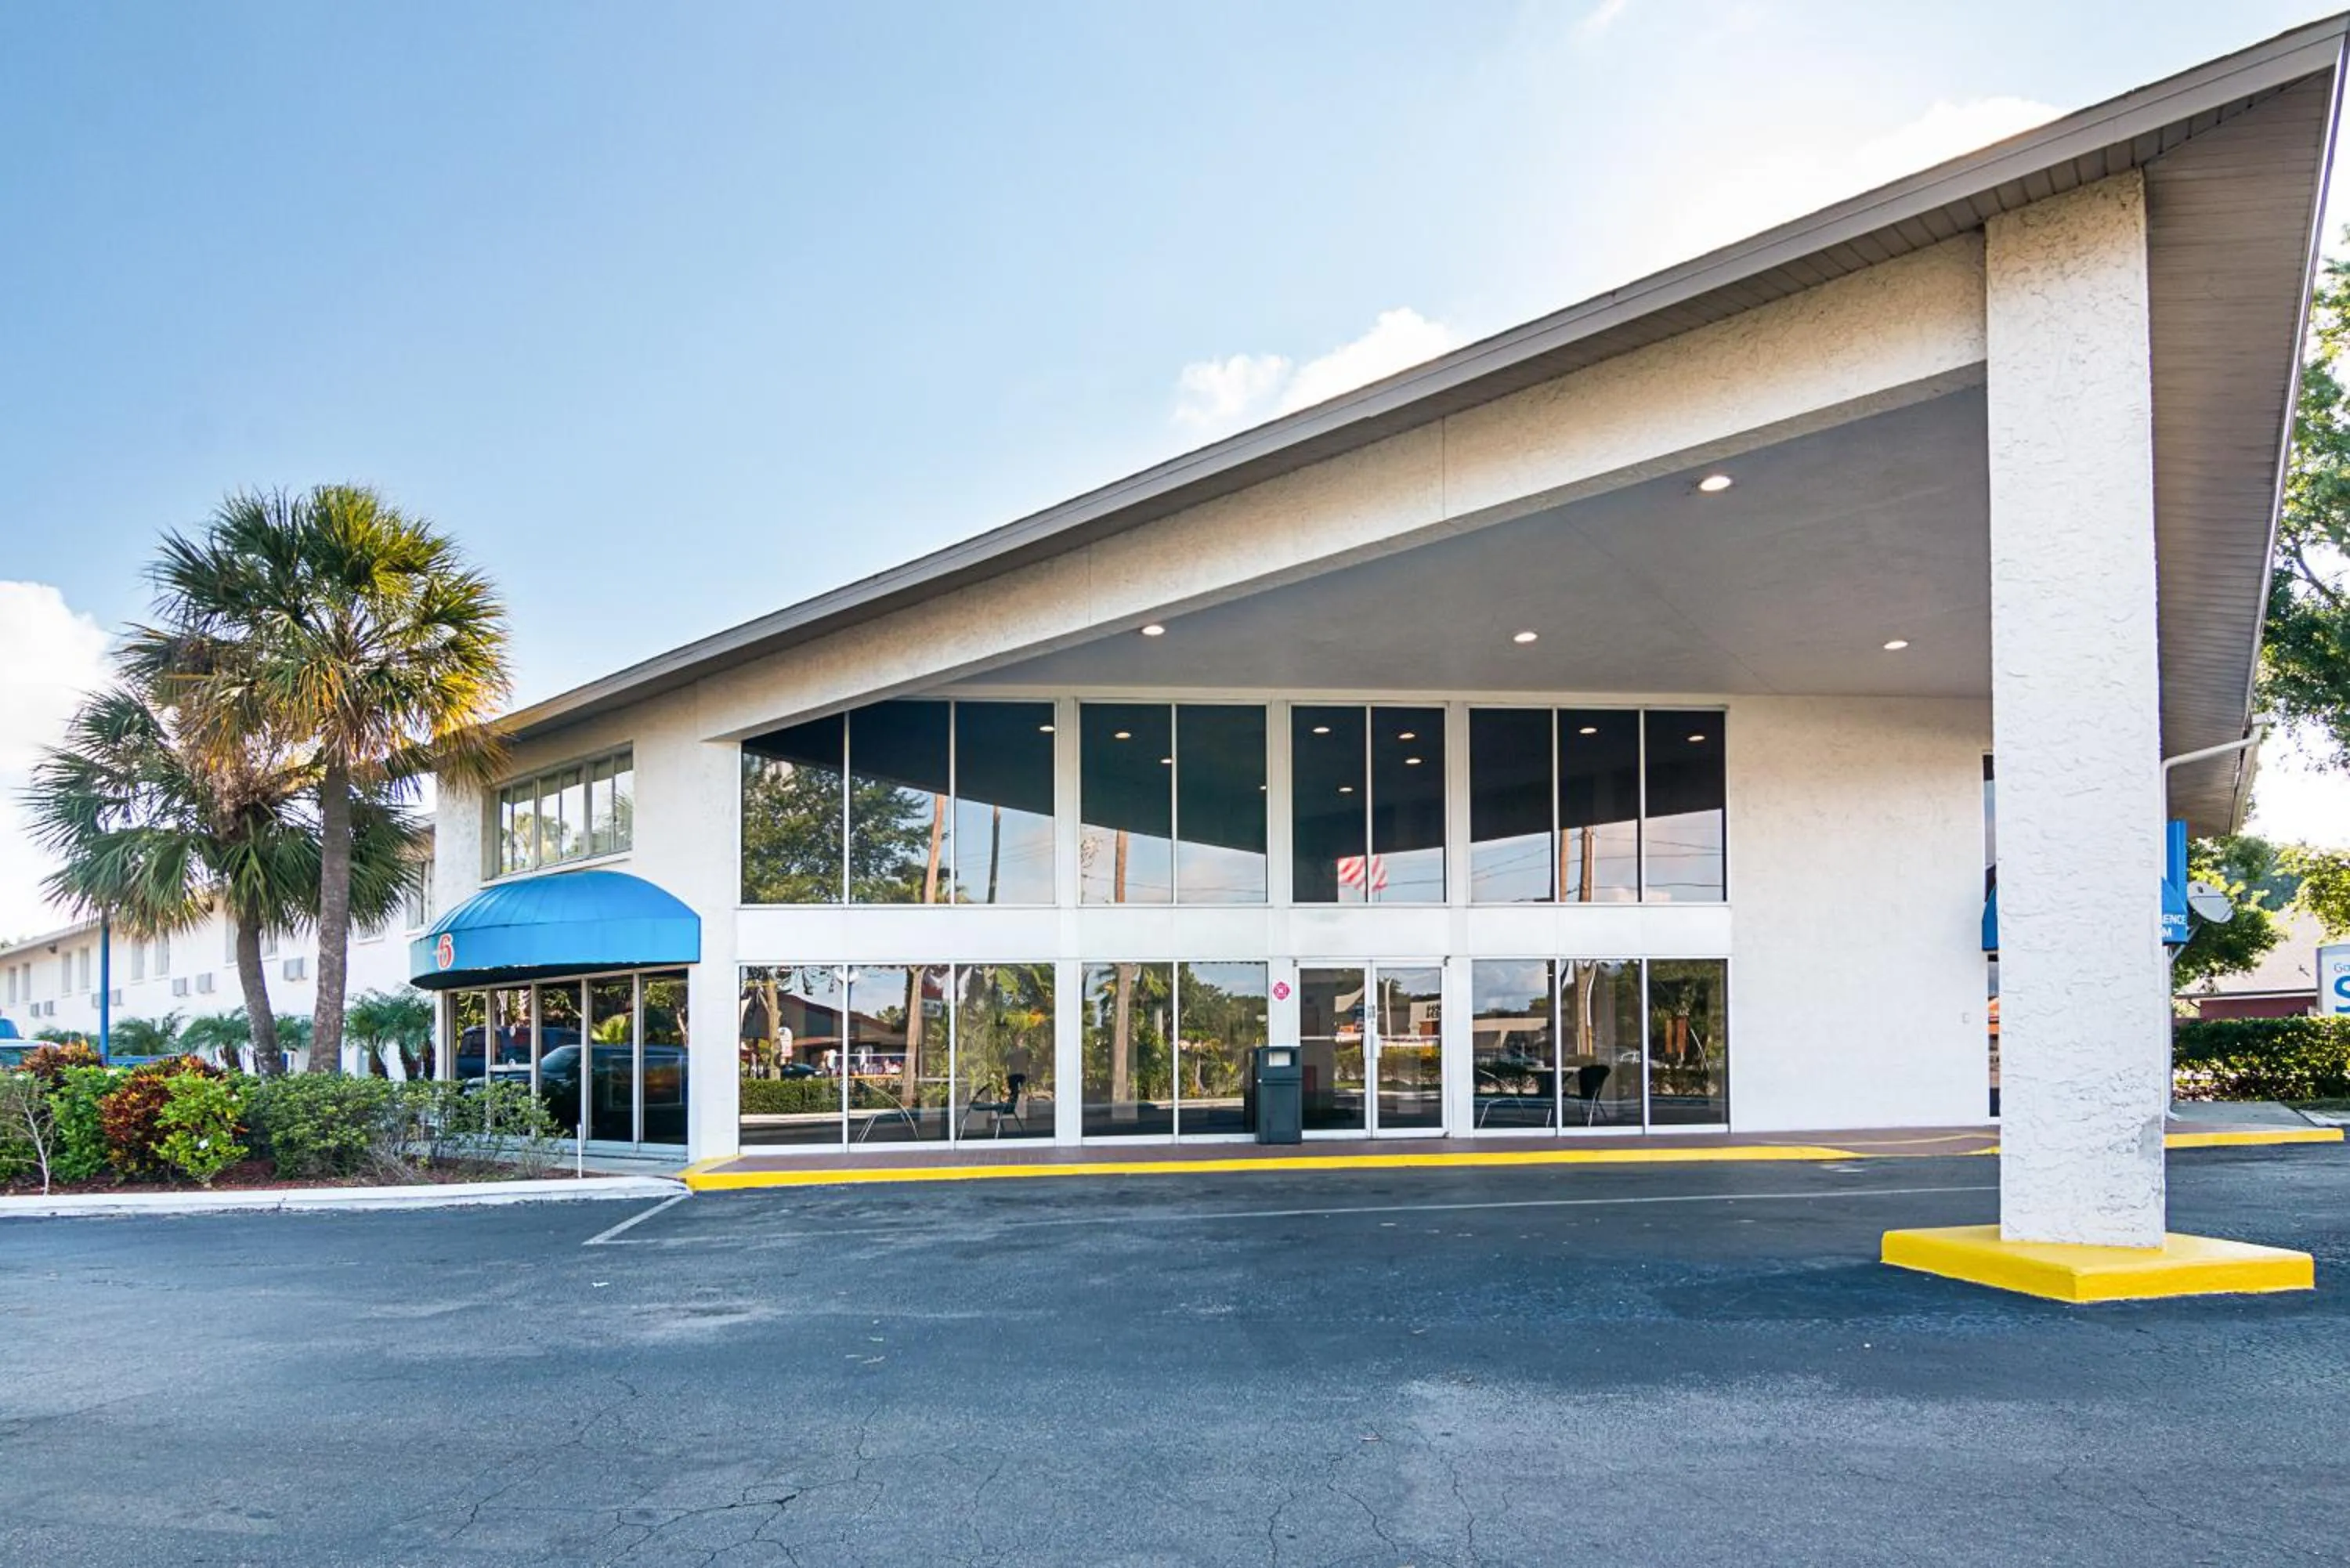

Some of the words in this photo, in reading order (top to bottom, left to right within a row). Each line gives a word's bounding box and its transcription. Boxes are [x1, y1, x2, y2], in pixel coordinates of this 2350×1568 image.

[2162, 914, 2187, 925] ENCE
[2161, 926, 2172, 938] M
[437, 933, 454, 970] 6
